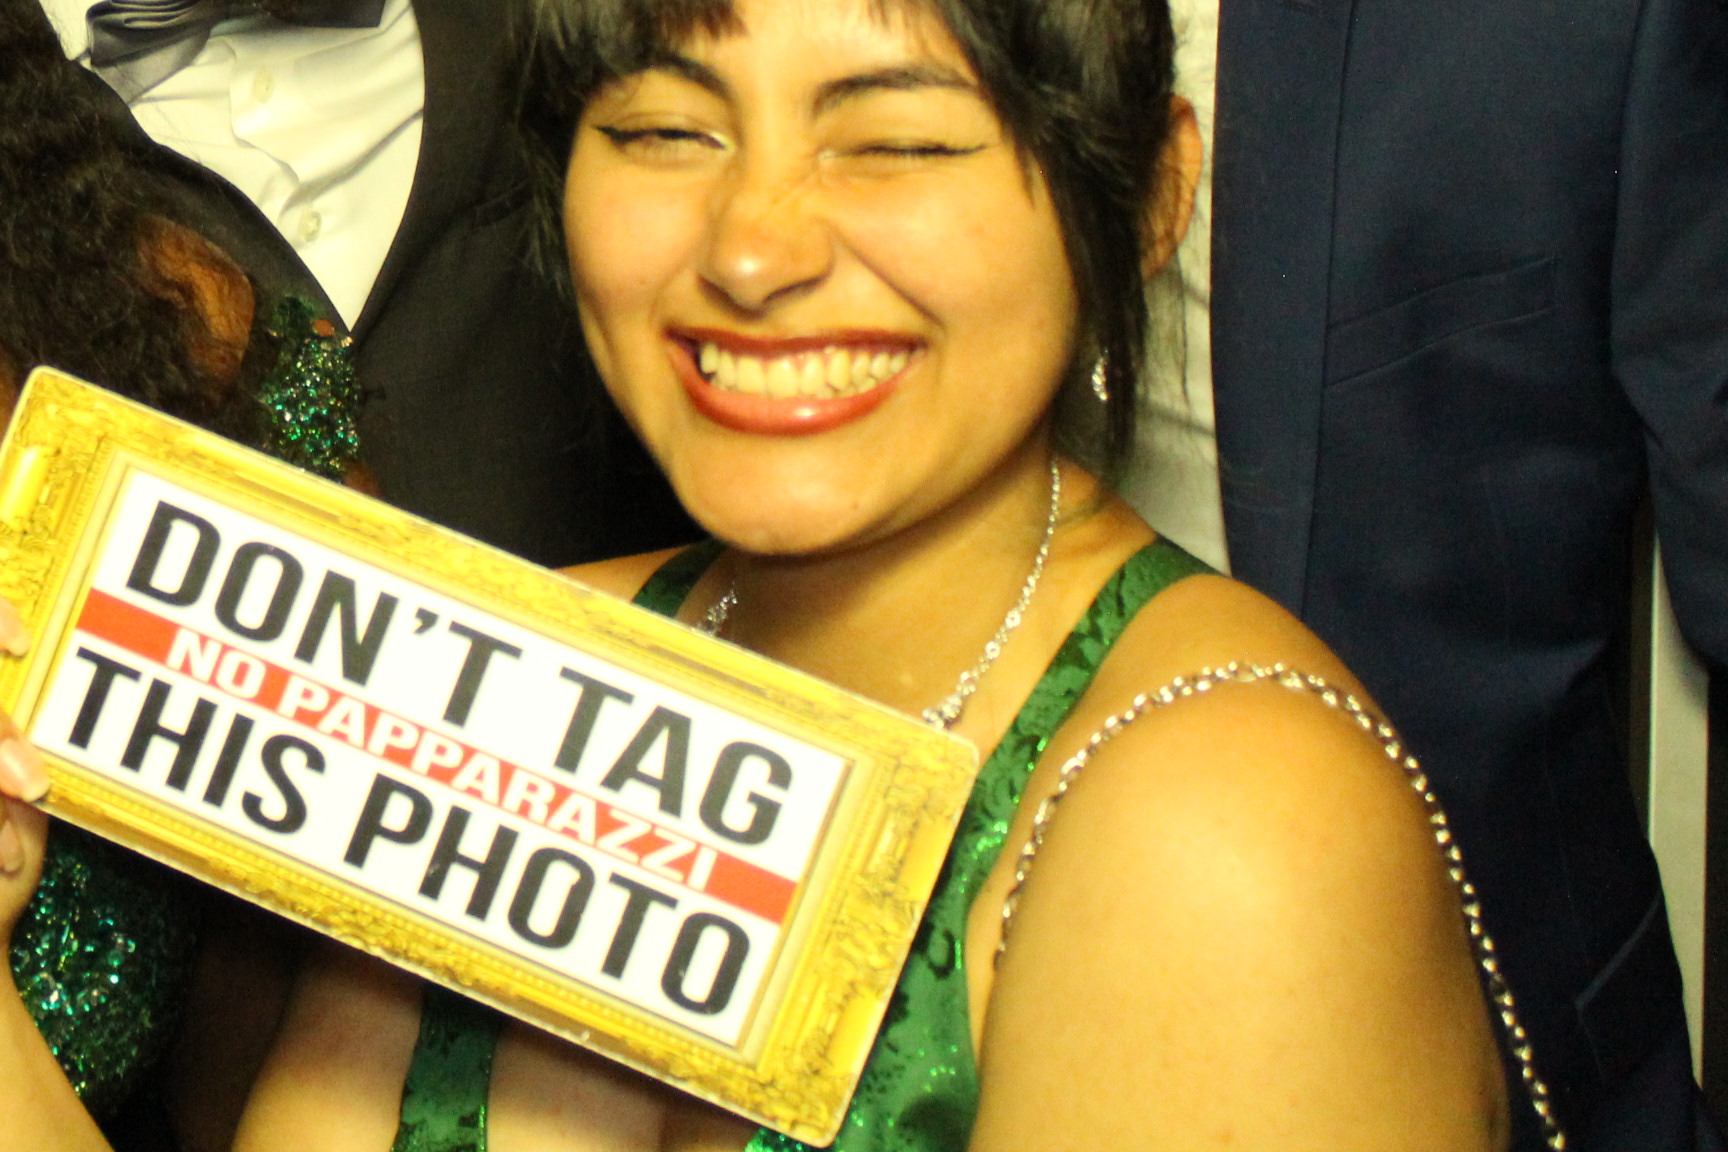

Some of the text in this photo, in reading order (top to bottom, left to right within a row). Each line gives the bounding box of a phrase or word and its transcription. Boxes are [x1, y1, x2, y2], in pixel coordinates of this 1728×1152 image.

[69, 647, 751, 1016] THIS PHOTO
[126, 501, 793, 847] DON'T TAG
[166, 630, 718, 891] NO PAPPARAZZI
